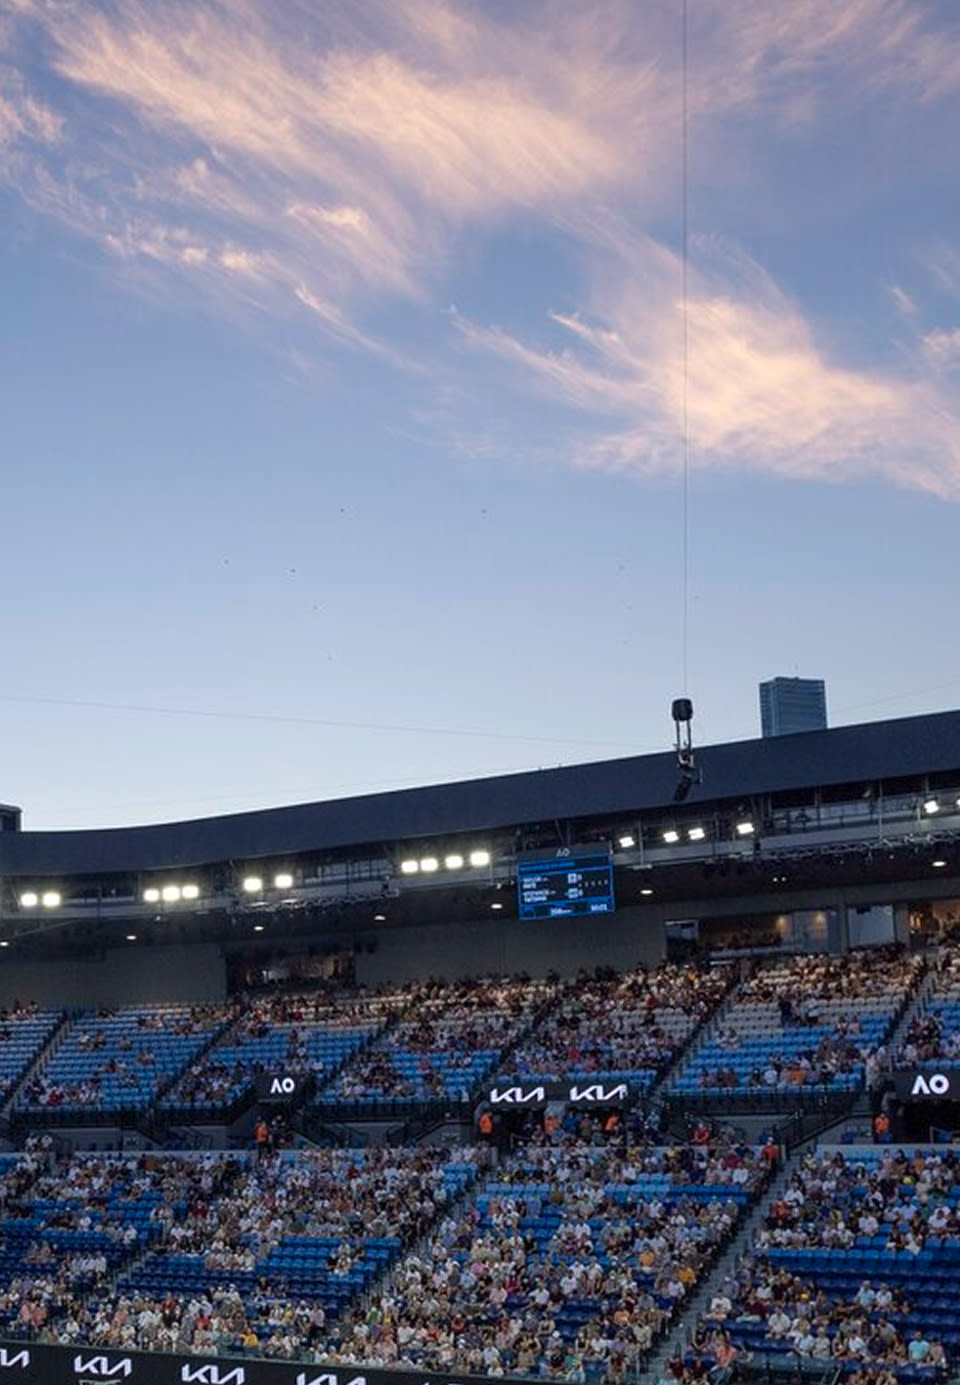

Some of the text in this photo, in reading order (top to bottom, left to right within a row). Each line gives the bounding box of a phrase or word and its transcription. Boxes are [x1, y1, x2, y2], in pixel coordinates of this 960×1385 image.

[270, 1077, 295, 1093] AO
[490, 1087, 545, 1103] KIA
[912, 1074, 950, 1095] AO
[74, 1355, 132, 1377] KIA
[181, 1364, 245, 1385] KIA
